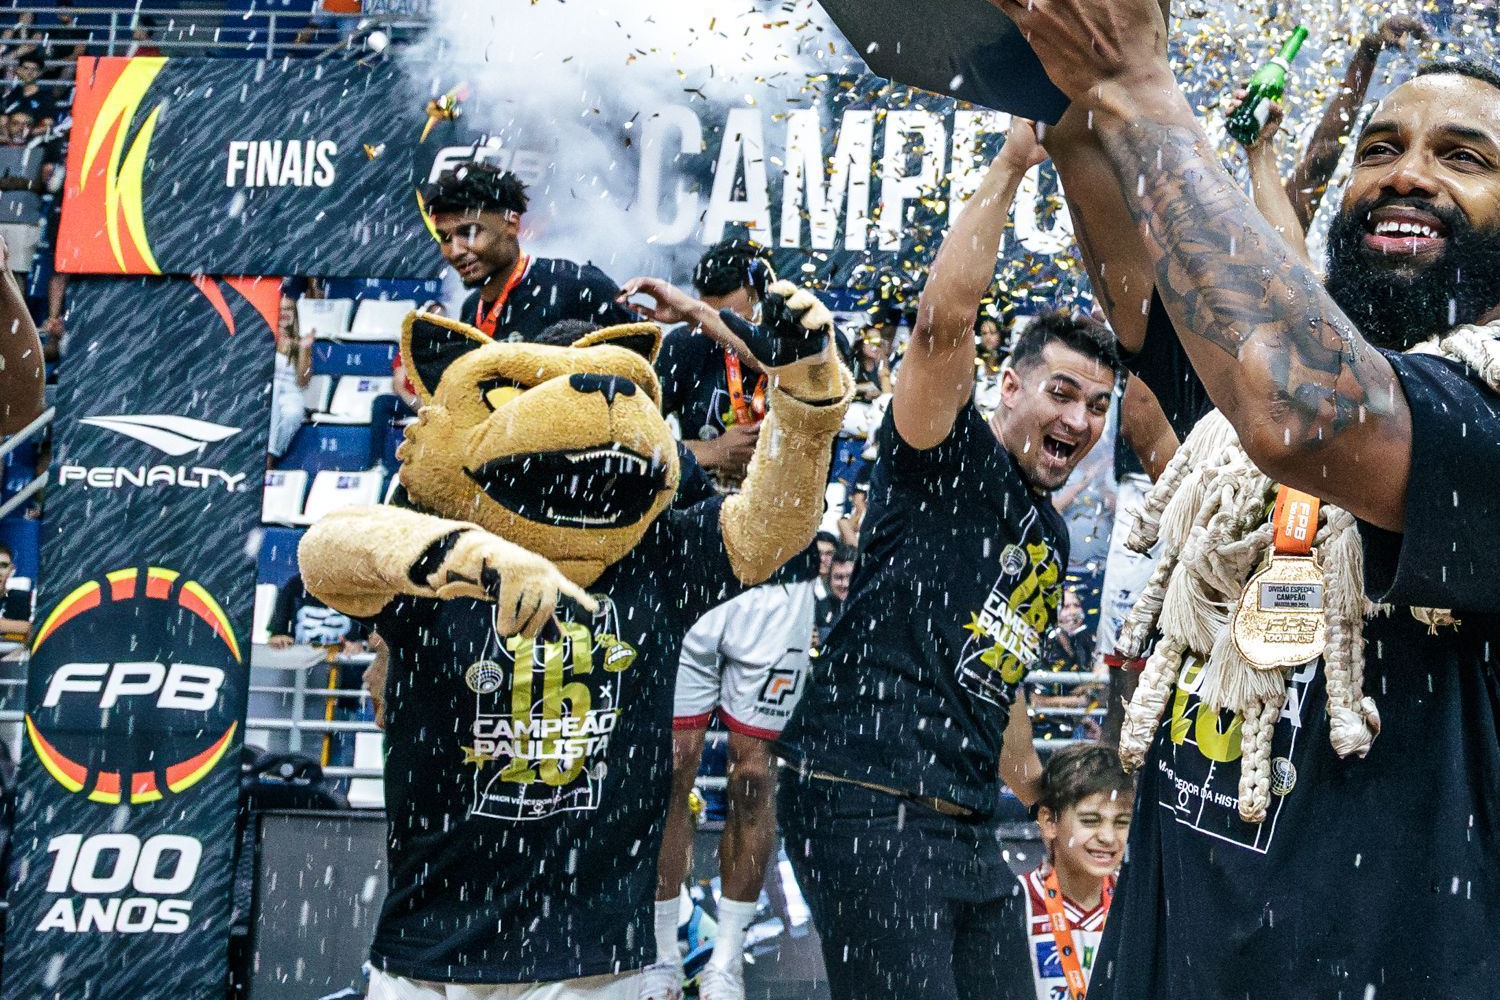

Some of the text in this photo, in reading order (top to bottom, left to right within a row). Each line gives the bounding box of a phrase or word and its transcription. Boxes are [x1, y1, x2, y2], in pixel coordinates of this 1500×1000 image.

[225, 140, 337, 188] FINAIS
[59, 465, 245, 489] PENALTY
[42, 661, 226, 711] FPB
[473, 710, 617, 738] CAMPEÃO
[474, 735, 609, 760] PAULISTA
[46, 833, 203, 895] 100
[36, 898, 195, 934] ANOS
